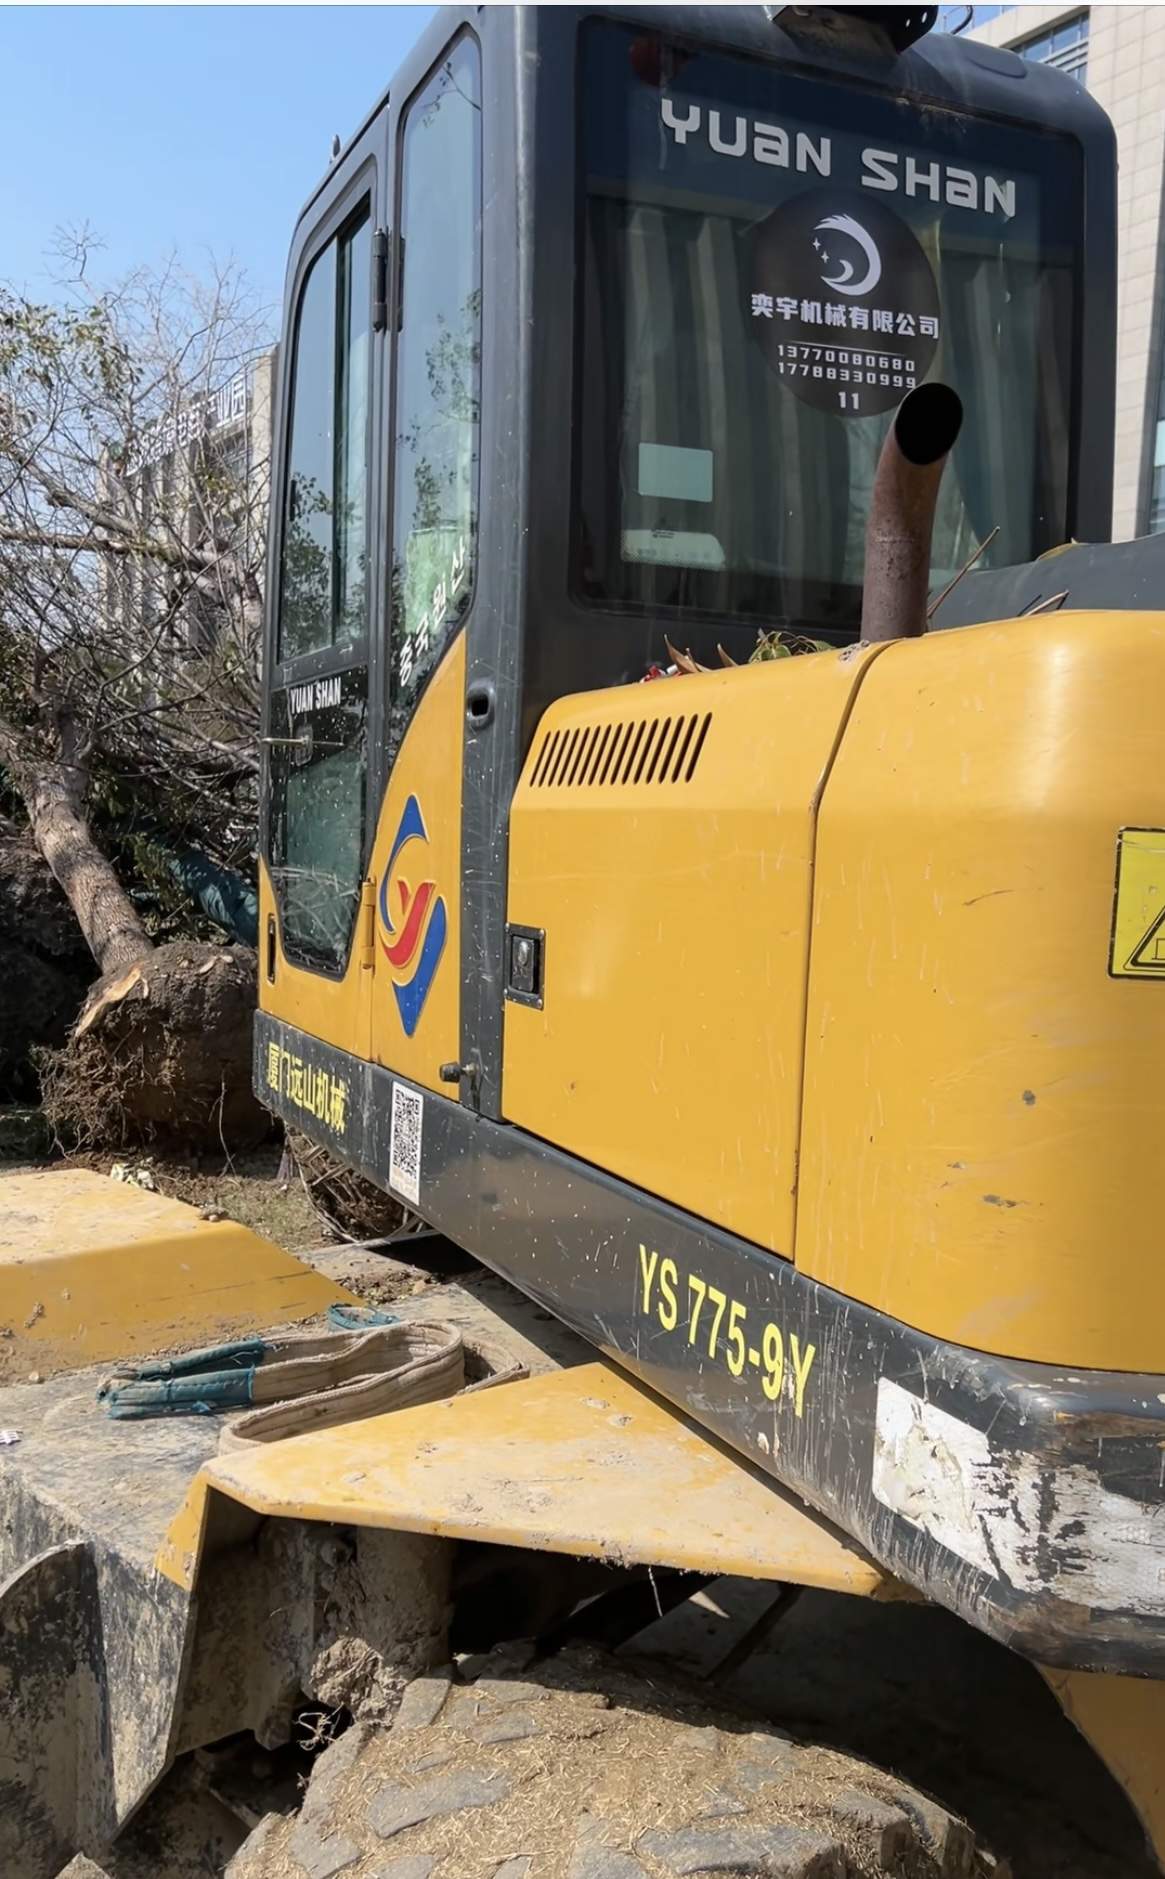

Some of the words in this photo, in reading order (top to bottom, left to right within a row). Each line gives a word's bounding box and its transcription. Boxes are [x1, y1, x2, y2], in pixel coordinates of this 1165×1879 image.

[777, 361, 916, 389] 17788330999
[838, 391, 859, 410] 11
[290, 684, 313, 714] YUAN
[315, 676, 341, 710] SHAN
[267, 1042, 346, 1135] 厦门远山机械
[639, 1243, 678, 1331] YS
[688, 1273, 816, 1418] 775-9Y
